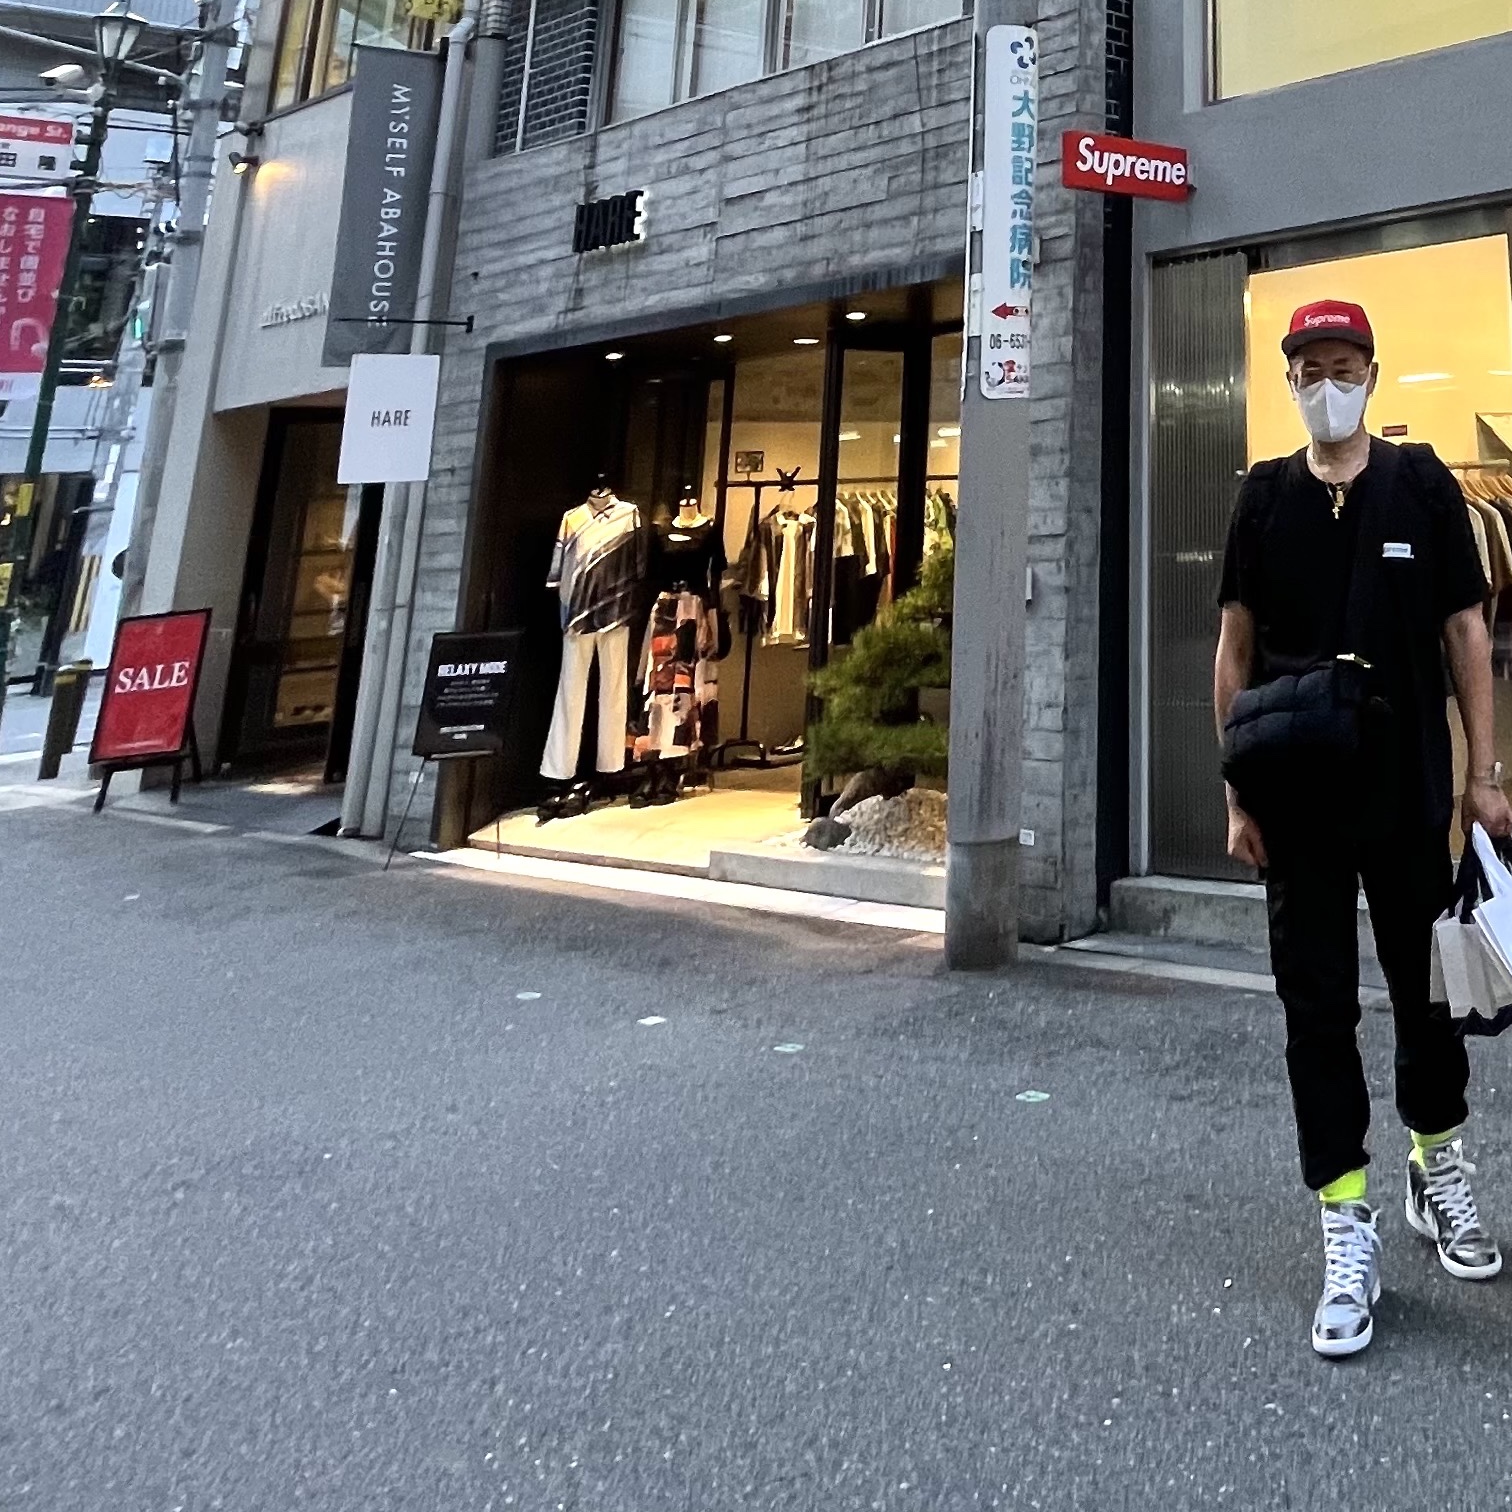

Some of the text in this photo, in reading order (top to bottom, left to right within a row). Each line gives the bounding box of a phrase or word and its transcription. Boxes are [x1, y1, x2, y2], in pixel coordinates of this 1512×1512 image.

[385, 83, 412, 178] MYSELF
[1076, 136, 1186, 186] Supreme
[573, 189, 645, 253] HARE
[1303, 314, 1351, 328] Supreme
[371, 409, 411, 428] HARE
[115, 661, 189, 694] SALE
